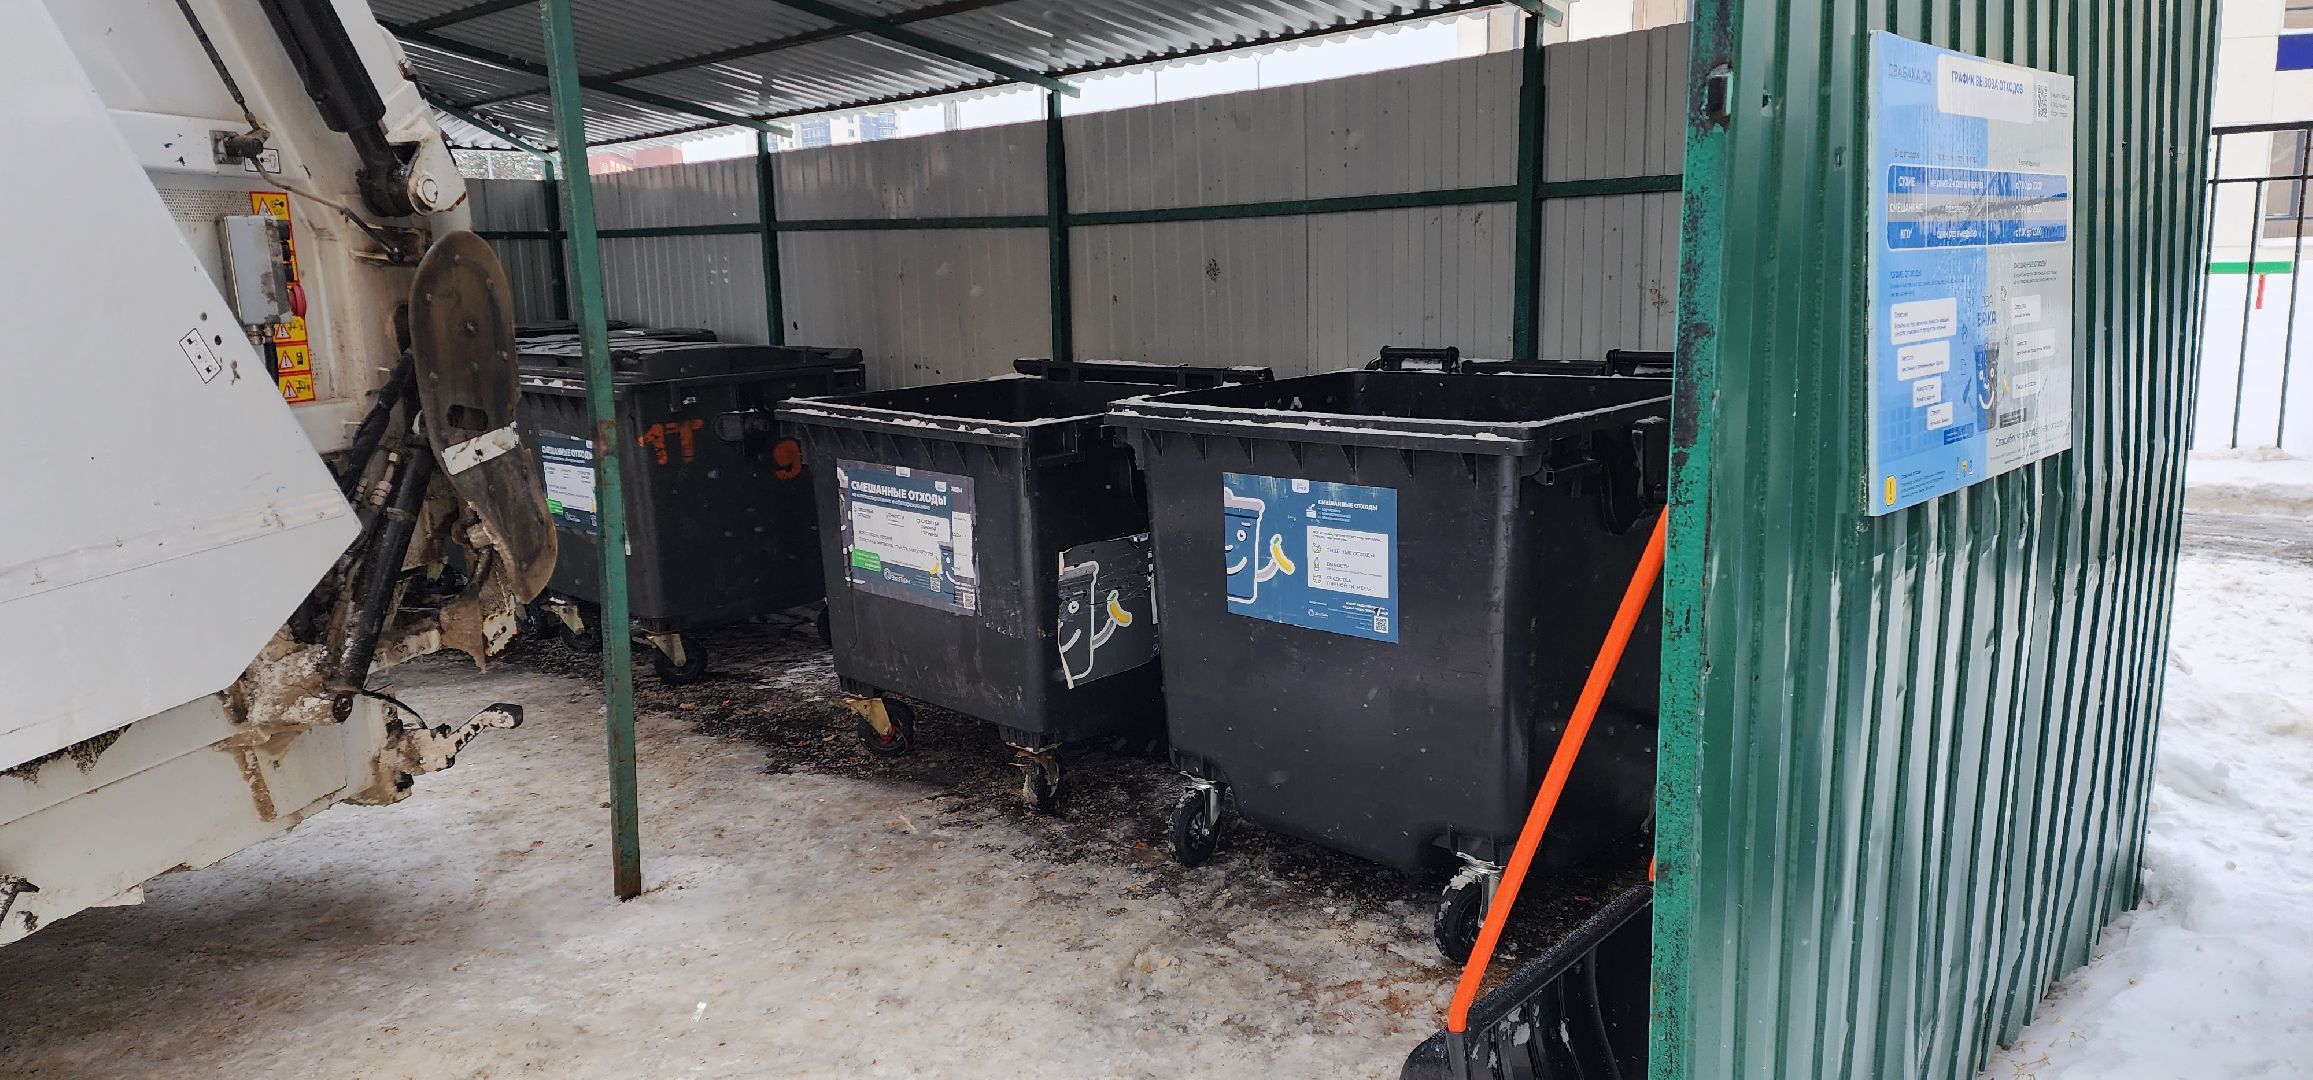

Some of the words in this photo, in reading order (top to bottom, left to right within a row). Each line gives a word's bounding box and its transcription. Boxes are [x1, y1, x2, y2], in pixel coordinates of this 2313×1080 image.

[1951, 70, 1975, 86] ГРАФИК
[1999, 79, 2024, 95] ОТХОДОВ
[1978, 310, 1997, 327] БАКА
[773, 439, 802, 480] 9
[850, 480, 907, 499] СМЕШАННЫЕ
[908, 489, 947, 506] ОТХОДЫ
[1354, 504, 1378, 512] ОТХОДЫ
